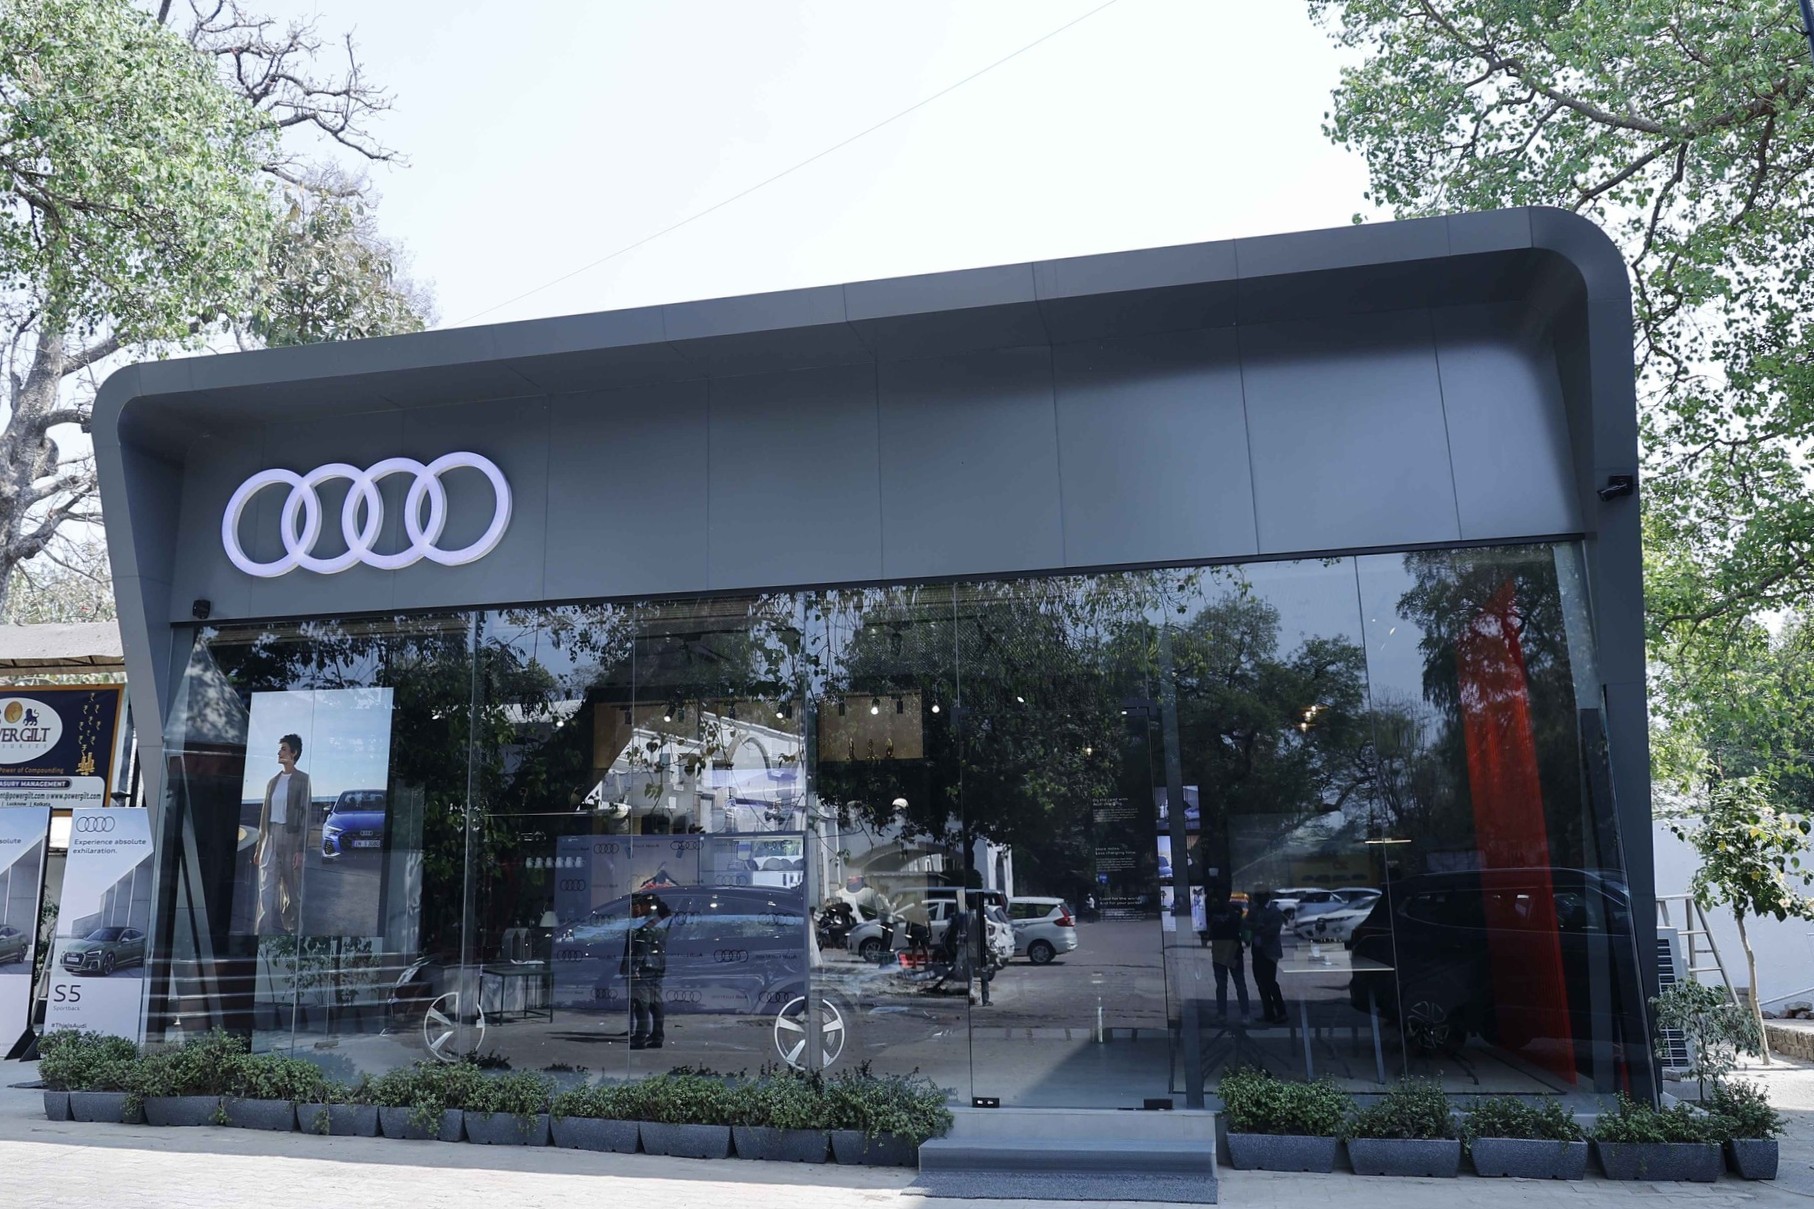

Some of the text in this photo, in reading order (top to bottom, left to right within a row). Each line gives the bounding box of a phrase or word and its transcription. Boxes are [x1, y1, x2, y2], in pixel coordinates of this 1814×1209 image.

[25, 767, 65, 775] Compounding
[51, 791, 102, 801] www.powergilt.com
[74, 838, 113, 847] Experience
[53, 984, 82, 1003] S5
